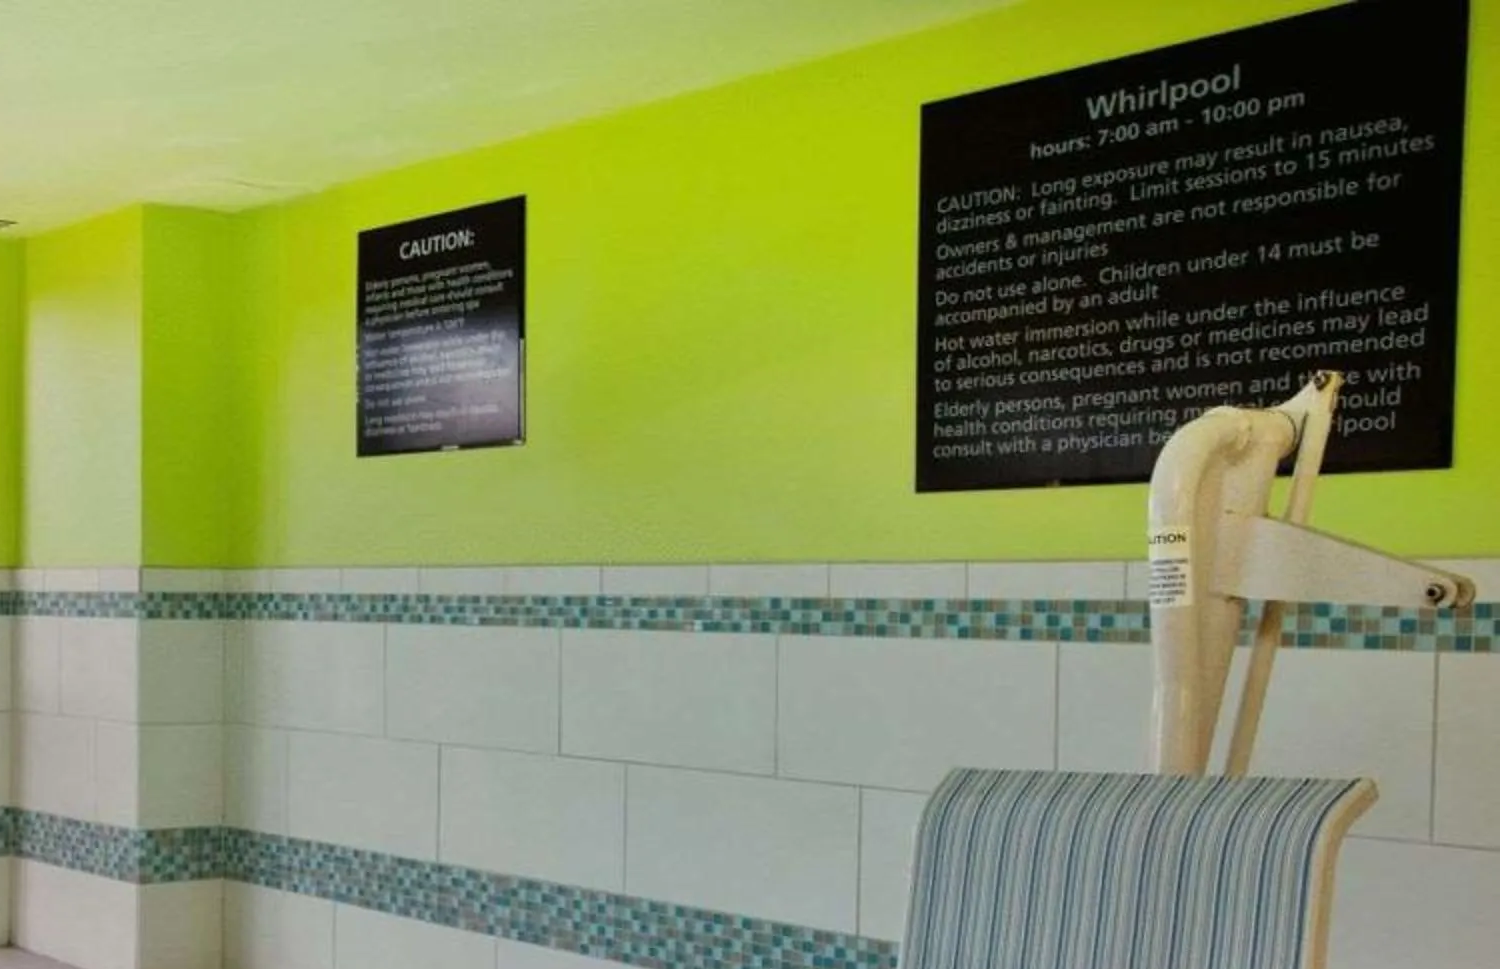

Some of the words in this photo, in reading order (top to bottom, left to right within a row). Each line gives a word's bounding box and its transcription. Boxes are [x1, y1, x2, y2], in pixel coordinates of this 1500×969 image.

[1086, 63, 1240, 120] Whirlpool
[1030, 135, 1090, 159] hours:
[1097, 122, 1140, 146] 7:00
[1144, 117, 1178, 136] am
[1201, 97, 1260, 124] 10:00
[1267, 92, 1304, 115] pm
[935, 209, 1010, 234] dizziness
[1015, 205, 1034, 220] or
[1039, 191, 1116, 216] fainting.
[1129, 177, 1178, 201] Limit
[1184, 164, 1266, 192] sessions
[1273, 160, 1297, 176] to
[1306, 149, 1330, 170] 15
[1338, 135, 1434, 163] minutes
[936, 184, 1020, 213] CAUTION:
[1031, 177, 1076, 197] Long
[1081, 160, 1169, 188] exposure
[1174, 151, 1218, 171] may
[1224, 135, 1283, 161] result
[1291, 133, 1312, 148] in
[1319, 117, 1407, 151] nausea,
[399, 229, 477, 260] CAUTION:
[935, 238, 1000, 260] Owners
[1004, 232, 1017, 249] &
[1022, 213, 1146, 246] management
[1151, 209, 1184, 226] are
[1190, 200, 1225, 219] not
[1232, 178, 1358, 212] responsible
[1366, 172, 1400, 190] for
[935, 256, 1013, 280] accidents
[1016, 253, 1036, 268] or
[1041, 241, 1108, 266] injuries
[935, 290, 959, 307] Do
[963, 285, 992, 302] not
[997, 282, 1026, 298] use
[1031, 274, 1086, 294] alone.
[1098, 261, 1180, 284] Children
[1187, 249, 1248, 272] under
[1258, 243, 1280, 262] 14
[1288, 236, 1341, 257] must
[1350, 231, 1379, 249] be
[934, 296, 1047, 325] accompanied
[1052, 295, 1074, 314] by
[1078, 293, 1102, 308] an
[1107, 281, 1158, 305] adult
[934, 335, 964, 352] Hot
[969, 330, 1019, 348] water
[1024, 319, 1119, 341] immersion
[1125, 309, 1179, 331] while
[1185, 303, 1247, 325] under
[1253, 298, 1290, 316] the
[1297, 285, 1405, 311] influence
[933, 354, 952, 372] of
[955, 347, 1022, 370] alcohol,
[1028, 339, 1112, 362] narcotics,
[1119, 335, 1174, 354] drugs
[1179, 331, 1201, 348] or
[1208, 319, 1315, 344] medicines
[1322, 314, 1370, 333] may
[1378, 302, 1428, 325] lead
[934, 378, 951, 392] to
[955, 372, 1015, 390] serious
[1018, 359, 1145, 384] consequences
[1150, 351, 1189, 372] and
[1195, 351, 1211, 367] is
[1215, 347, 1252, 365] not
[1259, 327, 1424, 360] recommended
[933, 399, 989, 419] Elderly
[994, 395, 1065, 417] persons,
[1071, 386, 1159, 411] pregnant
[1165, 380, 1242, 400] women
[1248, 371, 1290, 393] and
[1368, 361, 1421, 382] with
[933, 419, 986, 437] health
[990, 414, 1083, 434] conditions
[1087, 406, 1177, 428] requiring
[1338, 384, 1402, 409] ould
[932, 438, 996, 458] consult
[998, 434, 1036, 453] with
[1041, 438, 1052, 451] a
[1057, 429, 1142, 453] physician
[1148, 532, 1187, 545] UTION
